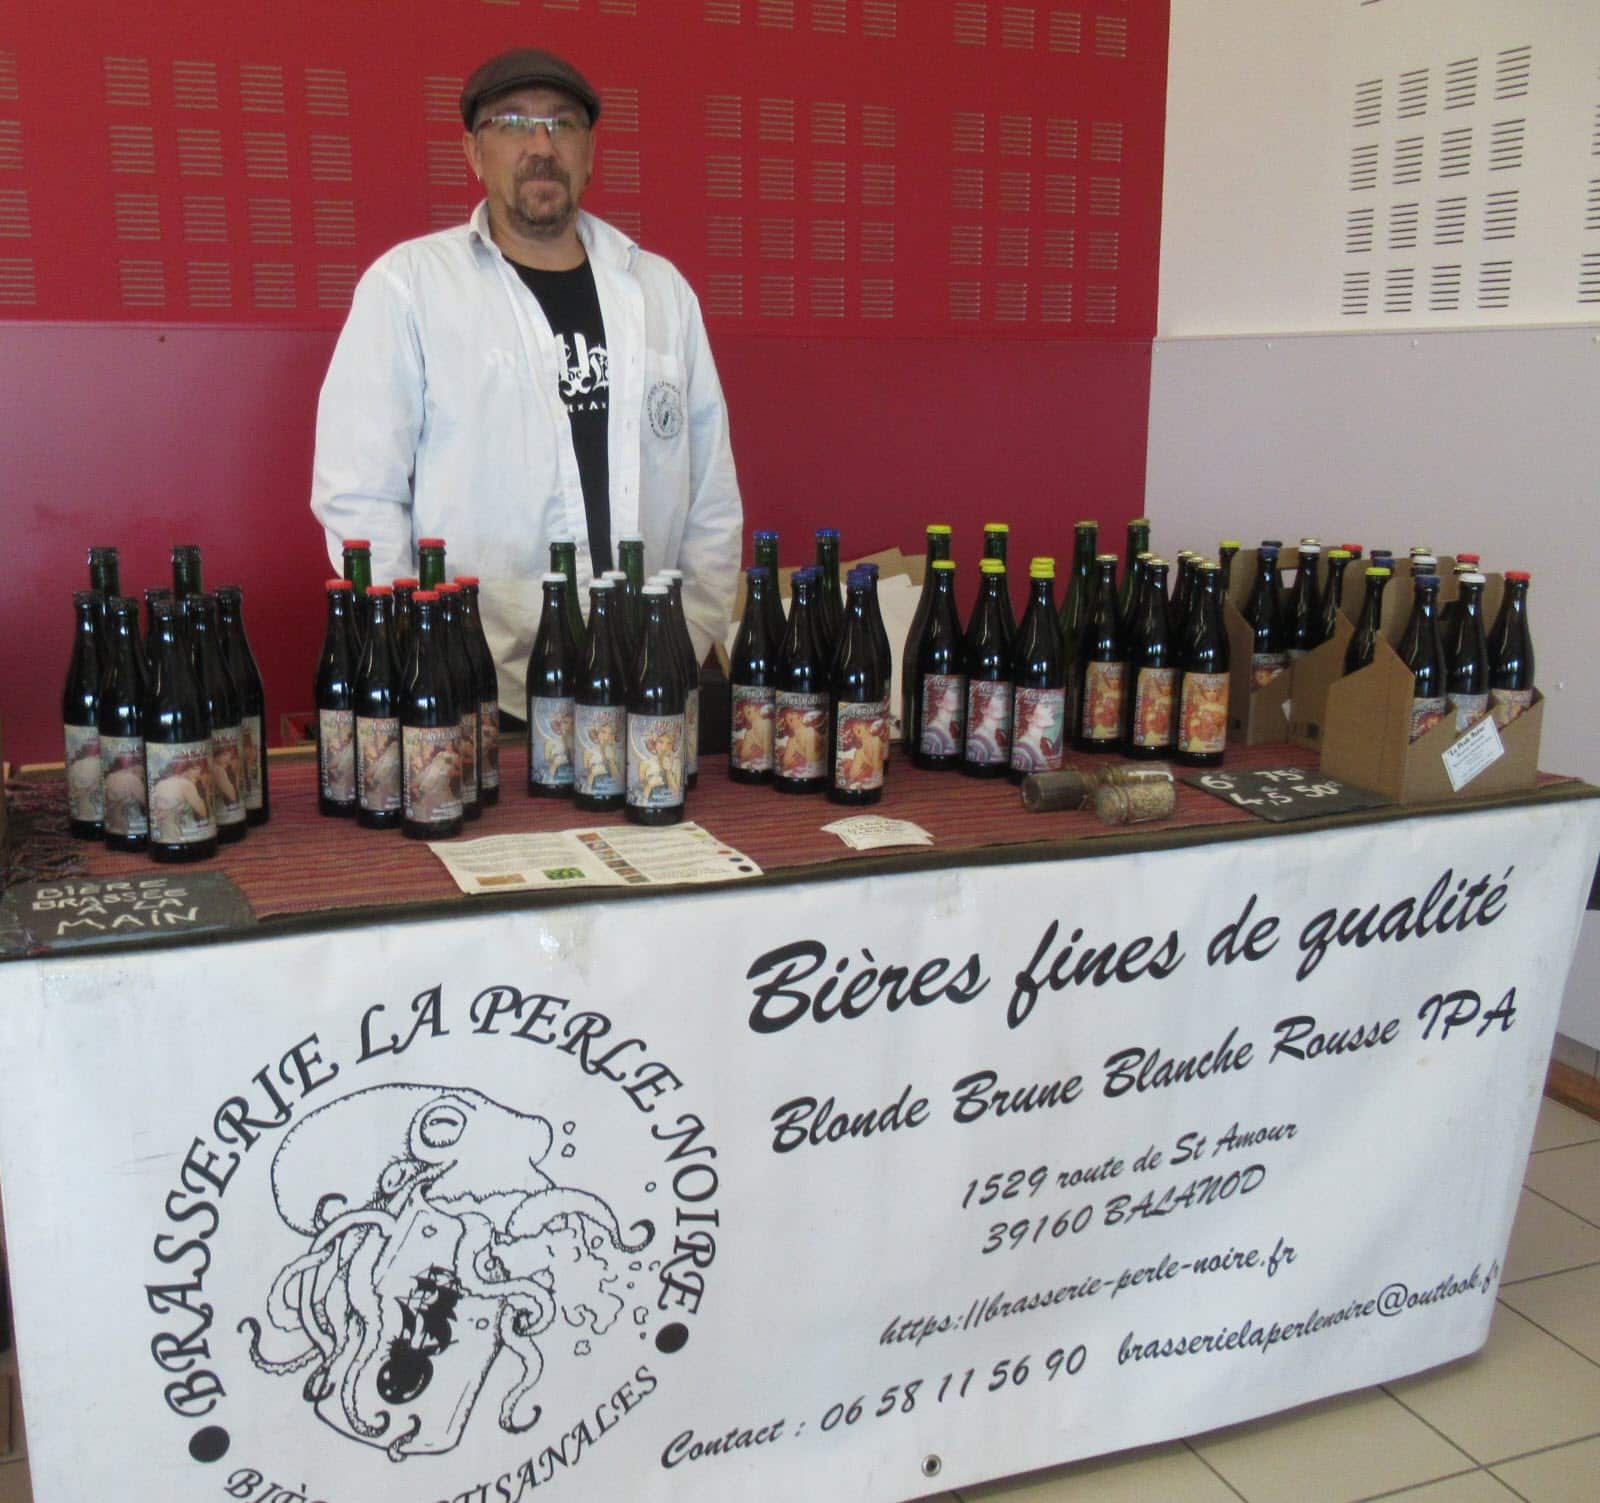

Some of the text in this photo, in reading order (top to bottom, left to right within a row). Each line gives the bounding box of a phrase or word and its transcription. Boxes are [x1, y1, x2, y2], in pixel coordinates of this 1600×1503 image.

[746, 866, 1512, 1034] Bières fines de qualité
[771, 986, 1517, 1153] Blonde Brune Blanche Rousse IPA
[145, 983, 720, 1418] BRASSERIE LA PERLE NOIRE
[962, 1122, 1298, 1209] 1529 route de St Amour
[982, 1163, 1266, 1254] 39160 BALANOD
[880, 1236, 1297, 1347] https://brasserie-perle-noire.fr
[660, 1418, 785, 1470] Contact
[820, 1395, 865, 1432] 06
[875, 1378, 924, 1418] 58
[937, 1367, 975, 1403] 11
[987, 1355, 1031, 1393] 56
[1045, 1343, 1087, 1382] 90
